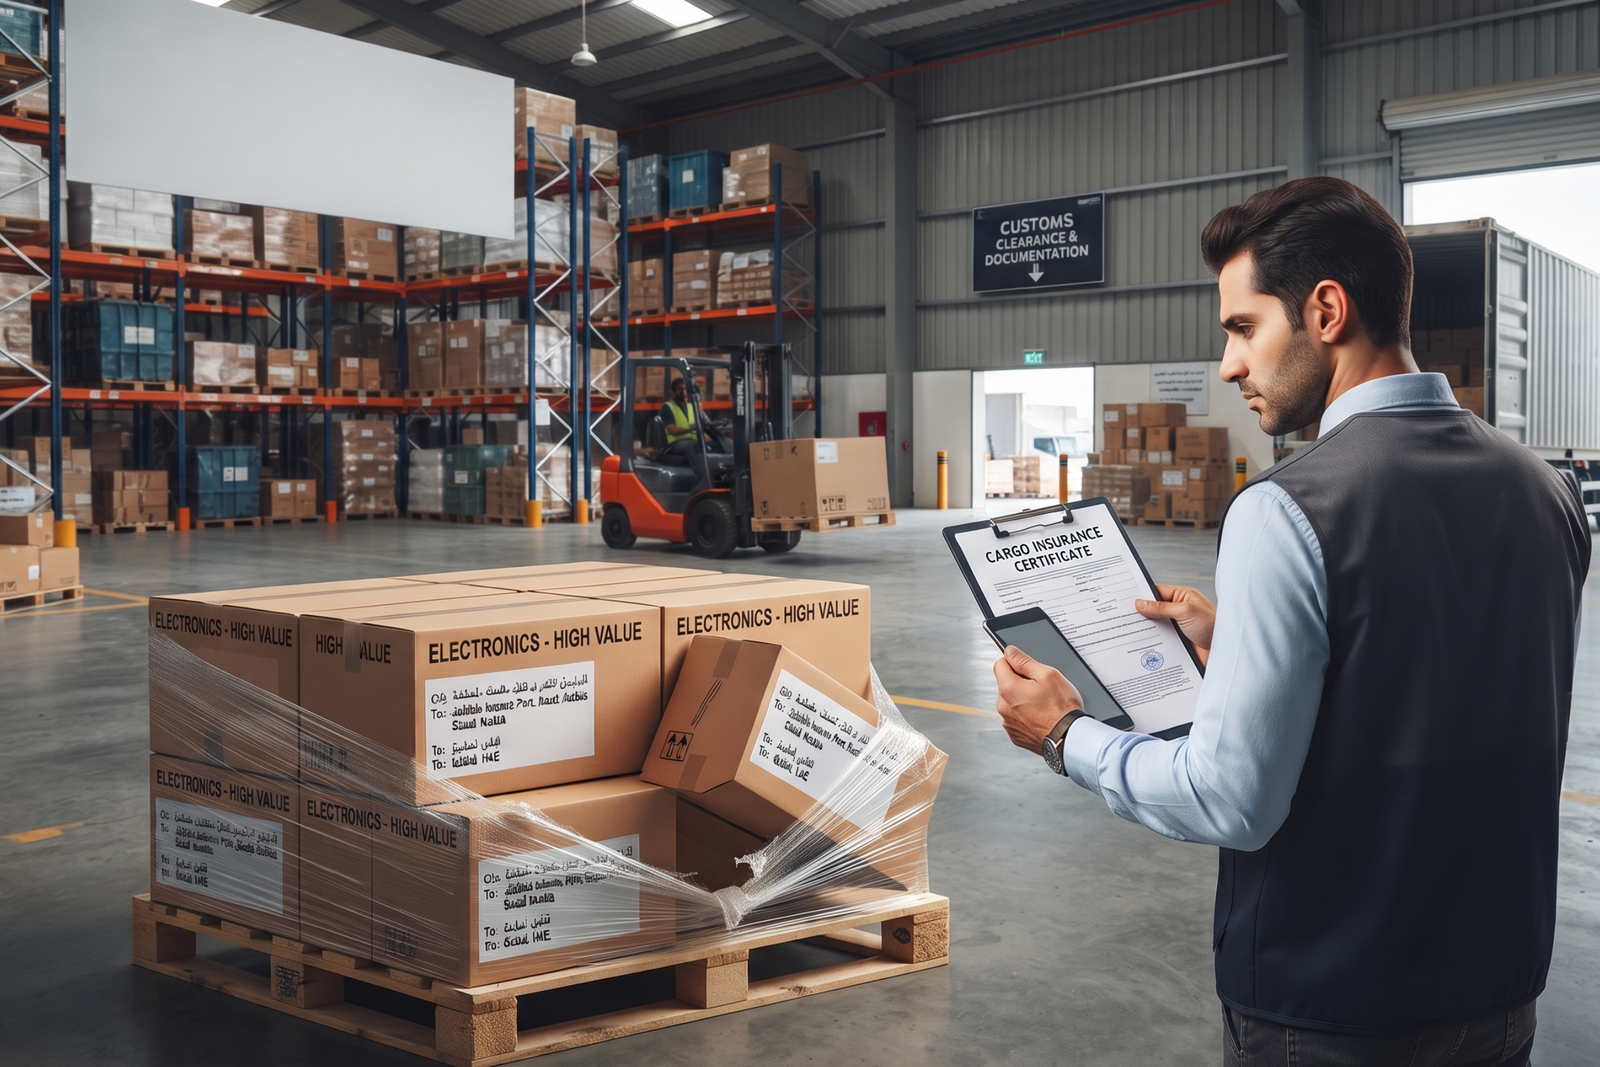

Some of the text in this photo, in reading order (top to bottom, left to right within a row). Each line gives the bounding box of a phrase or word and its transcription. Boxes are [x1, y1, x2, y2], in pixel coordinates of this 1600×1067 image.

[995, 230, 1078, 250] CLEARANCE &
[1000, 213, 1074, 235] CUSTOMS
[985, 244, 1089, 266] DOCUMENTATION
[985, 526, 1103, 563] CARGO INSURANCE
[1014, 545, 1093, 572] CERTIFICATE
[155, 612, 222, 637] ELECTRONICS
[230, 621, 255, 642] HIGH
[258, 625, 293, 648] VALUE
[677, 608, 772, 636] ELECTRONICS
[784, 603, 815, 624] HIGH
[819, 599, 859, 619] VALUE
[315, 633, 392, 664] HIGH ALUE
[429, 633, 540, 664] ELECTRONICS
[554, 627, 590, 649] HIGH
[595, 622, 642, 645] VALUE
[156, 769, 222, 798] ELECTRONICS
[229, 783, 254, 805] HIGH
[256, 789, 290, 812] VALUE
[307, 799, 381, 830] ELECTRONICS
[390, 816, 418, 840] HIGH
[421, 823, 457, 849] VALUE
